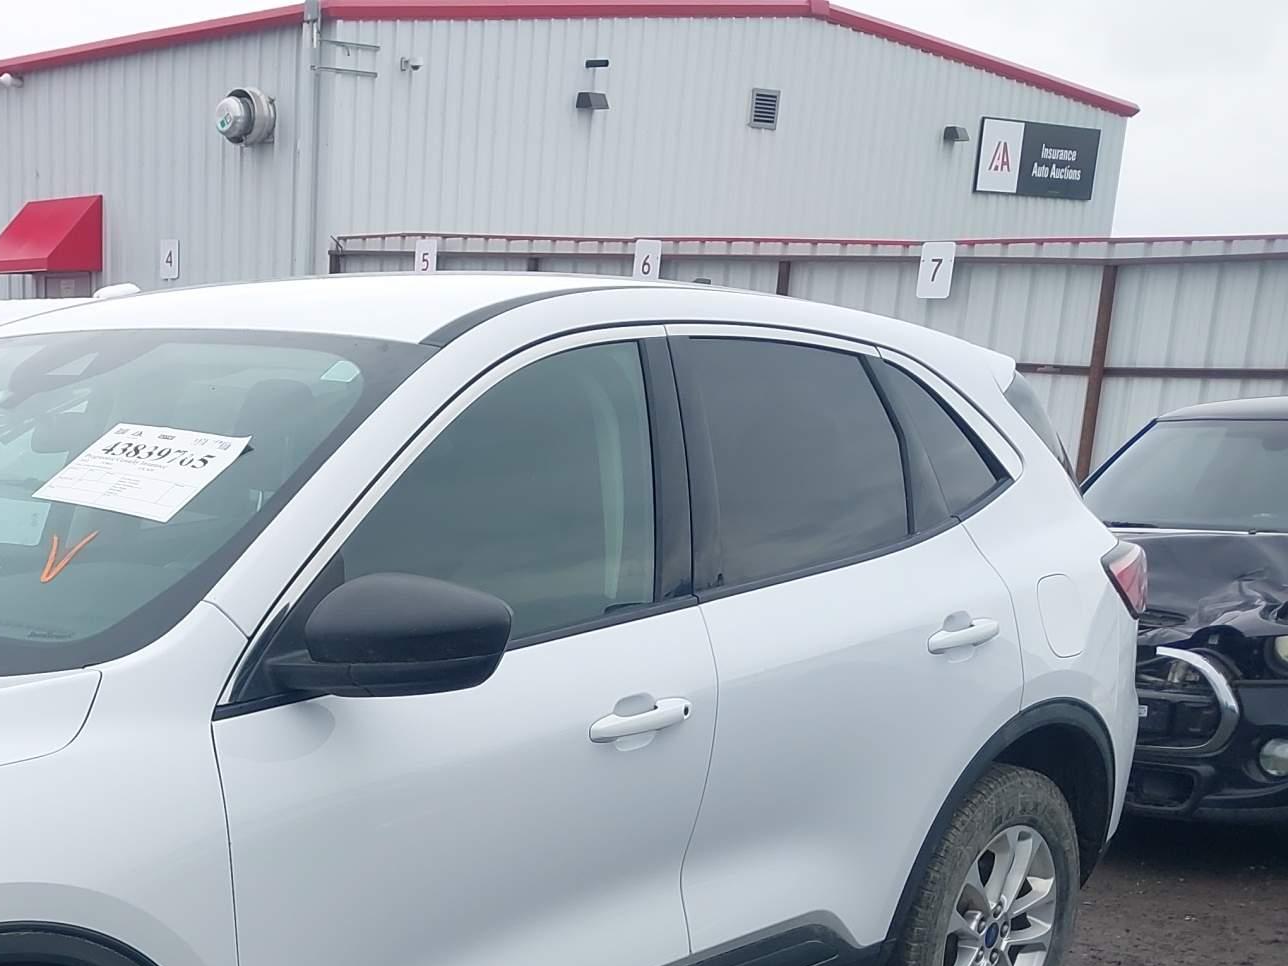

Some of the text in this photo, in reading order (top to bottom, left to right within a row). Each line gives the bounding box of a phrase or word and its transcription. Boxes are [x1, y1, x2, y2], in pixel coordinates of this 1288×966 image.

[1041, 143, 1077, 161] Insurance
[1031, 162, 1081, 181] Auto Auctions
[165, 250, 173, 267] 4
[421, 252, 430, 272] 5
[641, 254, 651, 275] 6
[931, 258, 943, 282] 7
[101, 441, 217, 470] 43839765
